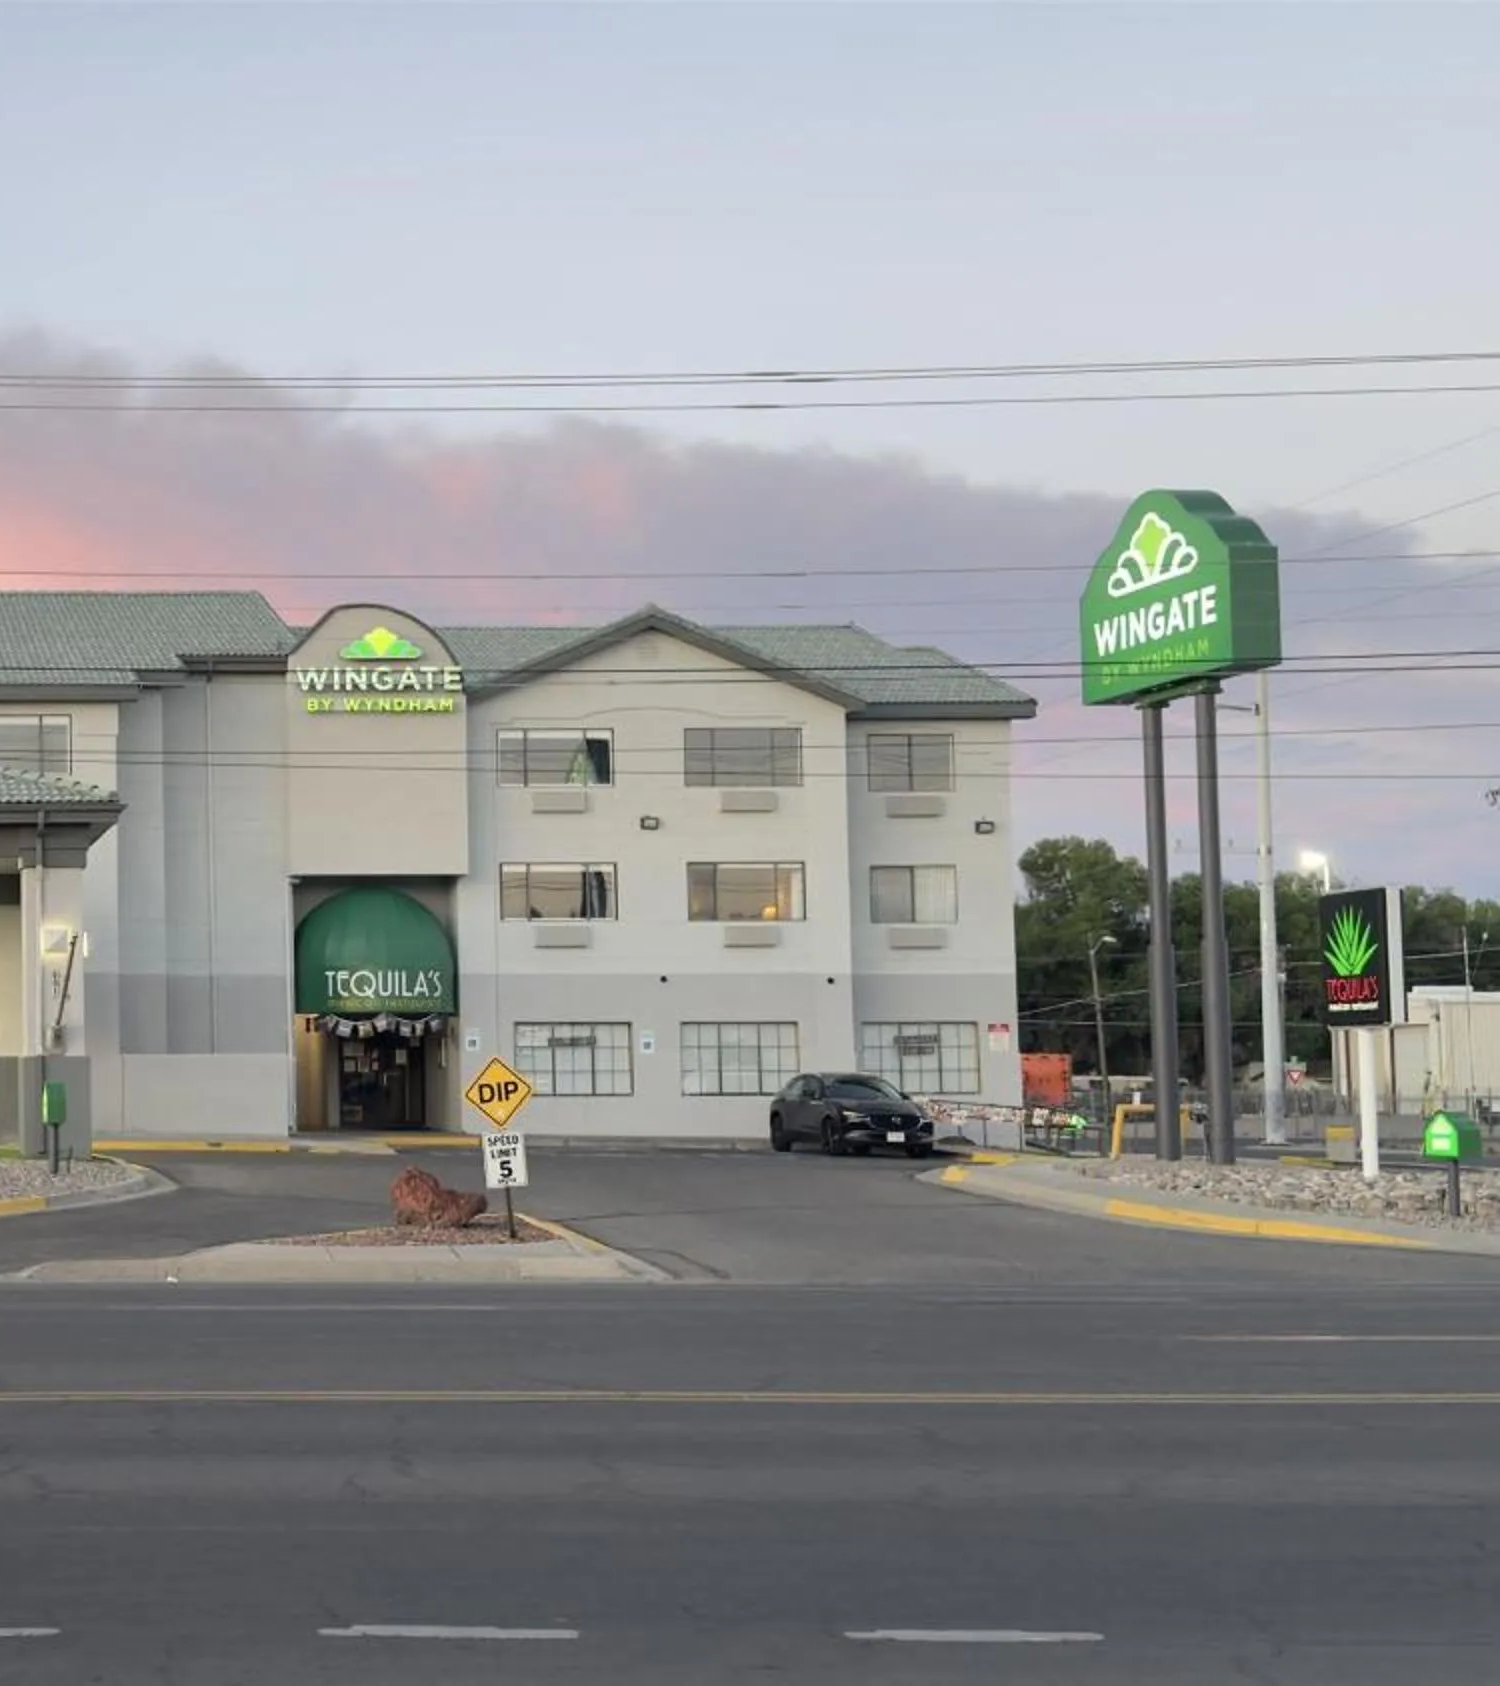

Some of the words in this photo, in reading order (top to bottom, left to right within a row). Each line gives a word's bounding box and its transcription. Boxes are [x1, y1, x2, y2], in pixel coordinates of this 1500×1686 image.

[1093, 585, 1217, 657] WINGATE
[297, 665, 462, 691] WINGATE
[307, 698, 333, 712] BY
[344, 698, 453, 712] WYNDHAM
[324, 969, 442, 998] TEQUILA'S
[1325, 975, 1379, 1001] TEQUILA'S
[478, 1081, 519, 1104] DIP
[487, 1135, 519, 1147] SPEED
[490, 1147, 517, 1159] LIMIT
[499, 1160, 513, 1178] 5
